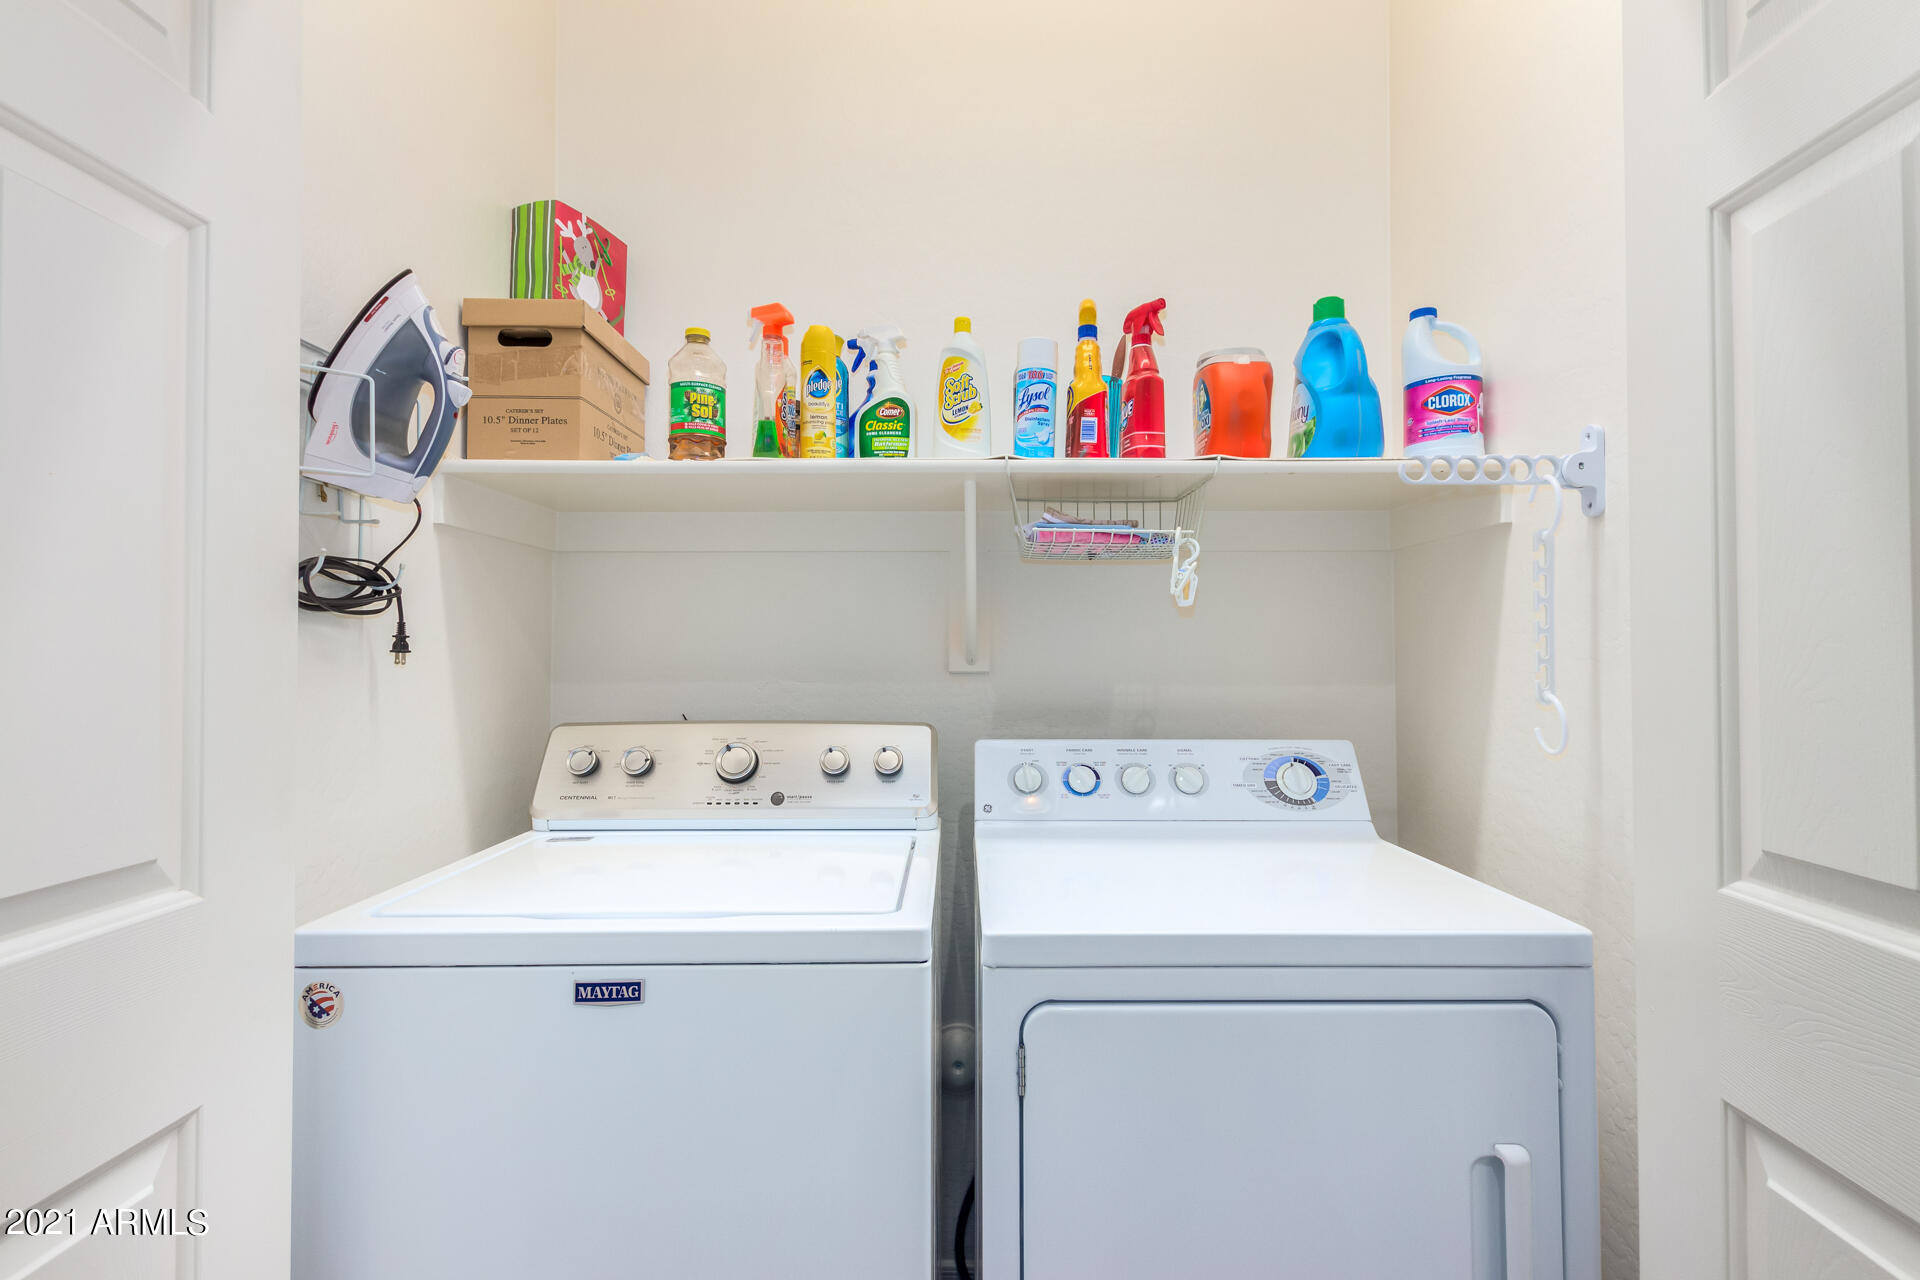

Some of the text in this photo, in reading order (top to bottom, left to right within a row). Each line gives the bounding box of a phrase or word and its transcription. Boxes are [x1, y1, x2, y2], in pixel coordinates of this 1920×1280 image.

[806, 379, 832, 397] pledge
[945, 374, 973, 395] Soft
[944, 384, 977, 410] Scrub
[1018, 387, 1050, 410] Lysol
[1428, 394, 1471, 409] CLOROX
[691, 404, 713, 419] Sol
[879, 407, 900, 416] Comet
[952, 404, 969, 416] LEMON
[482, 416, 568, 425] 10.5" Dinner Plates
[865, 420, 904, 431] Classic
[302, 982, 340, 1001] AMERICA
[577, 985, 639, 999] MAYTAG
